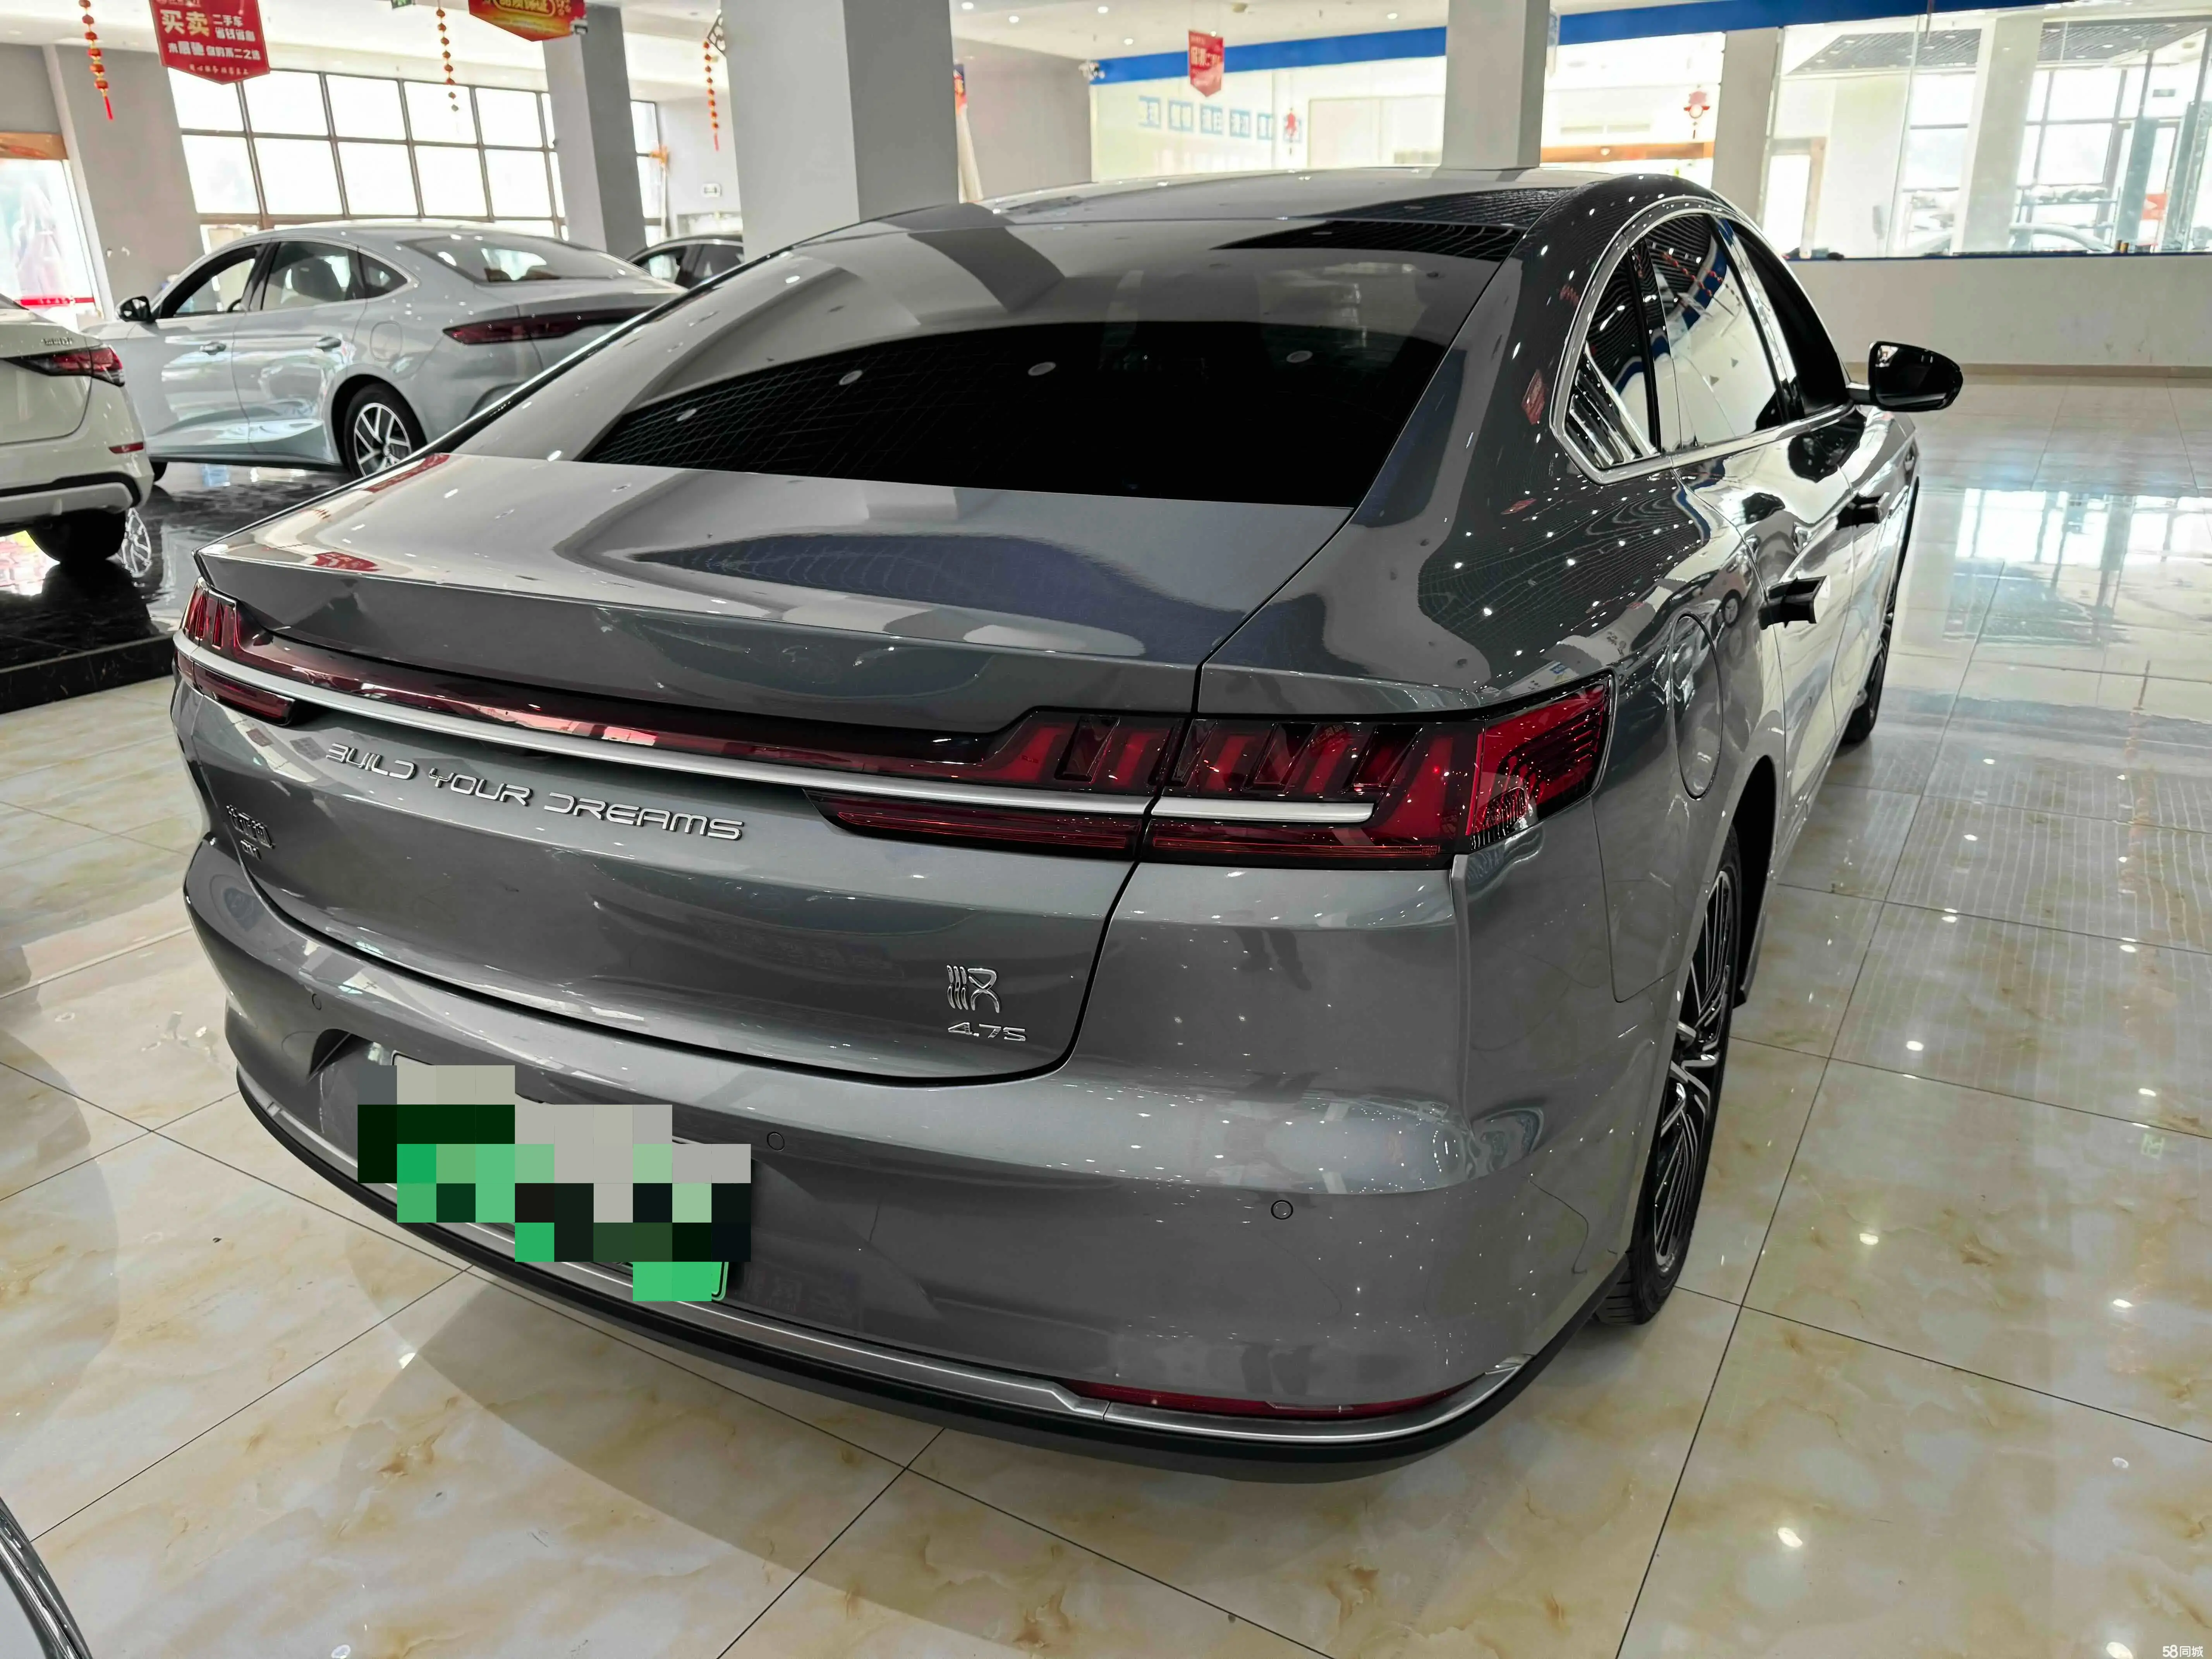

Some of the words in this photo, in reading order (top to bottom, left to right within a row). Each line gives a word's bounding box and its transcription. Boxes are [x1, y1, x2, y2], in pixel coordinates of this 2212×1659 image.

[160, 9, 210, 37] 买卖
[213, 14, 243, 27] 二手车
[326, 743, 417, 780] BUILD
[429, 767, 533, 806] YOUR
[544, 792, 744, 840] DREAMS
[948, 1022, 1025, 1041] 4.7S
